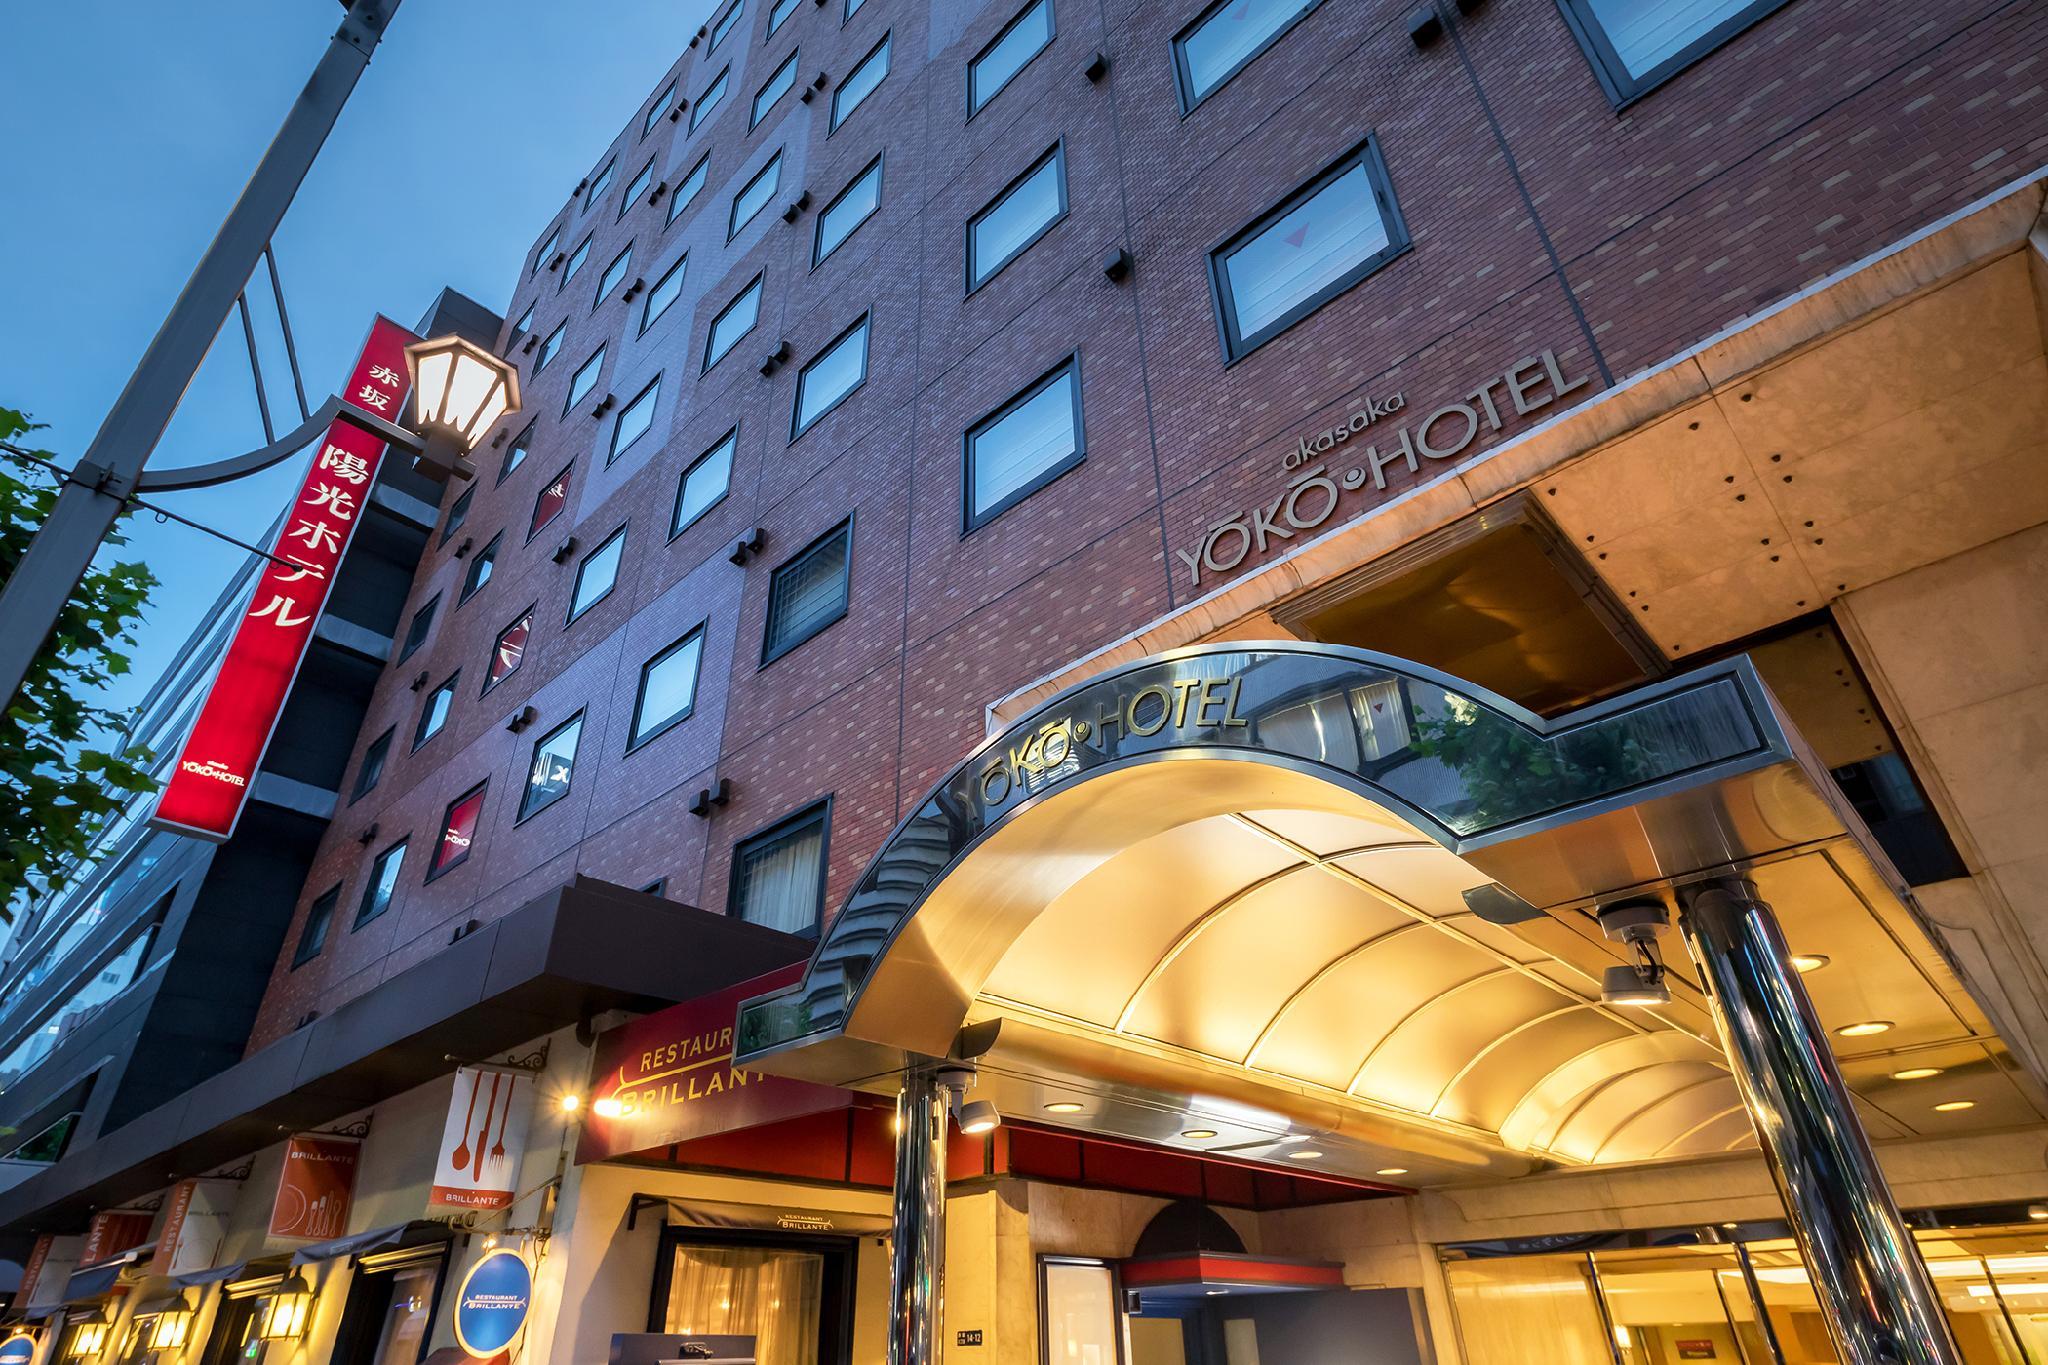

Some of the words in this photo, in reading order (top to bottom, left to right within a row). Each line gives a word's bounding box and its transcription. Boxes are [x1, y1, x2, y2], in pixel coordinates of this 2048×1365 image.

[359, 365, 400, 411] 赤坂
[1281, 391, 1405, 472] akasaka
[1366, 348, 1591, 491] HOTEL
[248, 443, 370, 627] 陽光ホテル
[1095, 675, 1249, 749] HOTEL
[640, 1026, 733, 1073] RESTAUR
[620, 1066, 764, 1116] BRILLAN
[291, 1151, 354, 1165] BRILLANTE
[163, 1185, 192, 1253] RESTAURANT
[445, 1193, 499, 1206] BRILLANTE
[785, 1214, 823, 1222] RESTAURANT
[84, 1214, 110, 1263] LANTE
[782, 1221, 829, 1231] BRILLANTE
[468, 1301, 521, 1309] BRILLANTE
